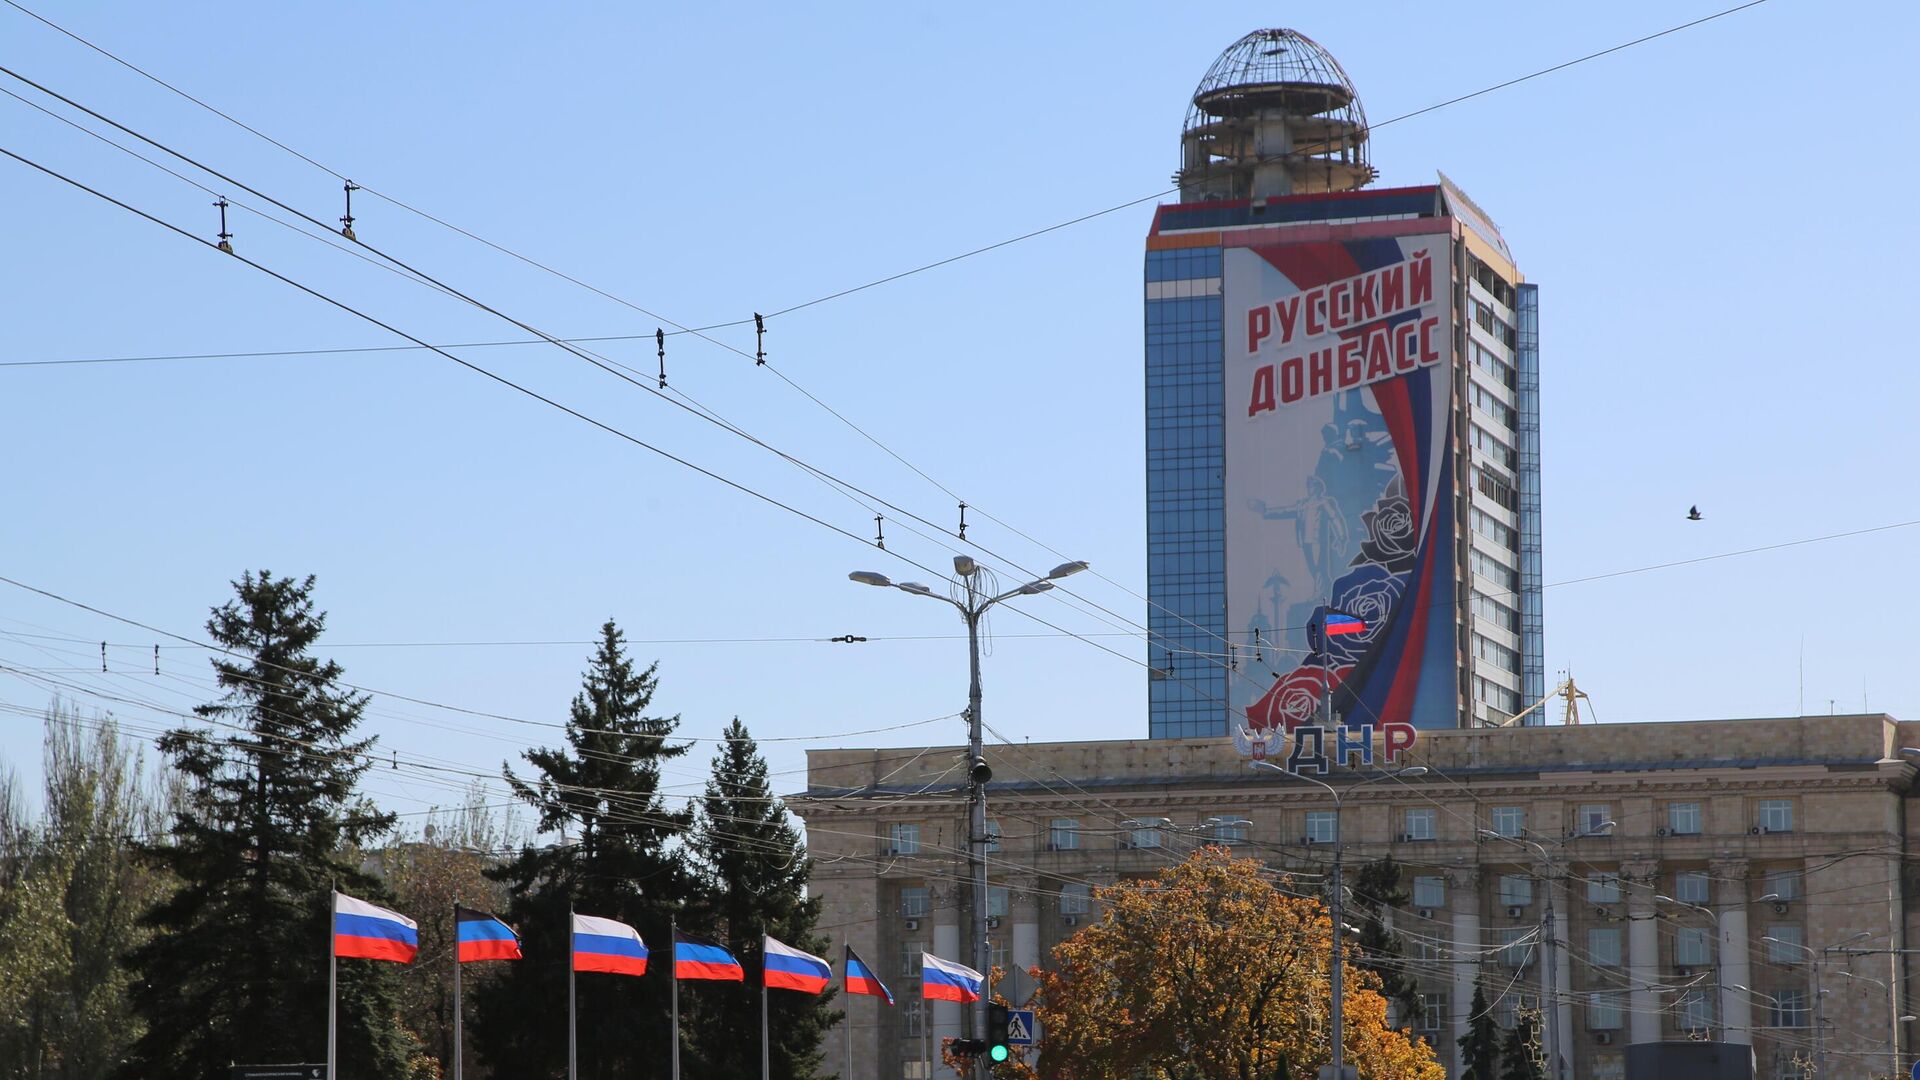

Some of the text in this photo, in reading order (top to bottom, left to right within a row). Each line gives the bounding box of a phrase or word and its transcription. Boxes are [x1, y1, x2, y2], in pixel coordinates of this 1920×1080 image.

[1248, 248, 1432, 353] РУССКИЙ
[1248, 317, 1439, 417] ДОНБАСС
[1287, 723, 1417, 774] ДНР
